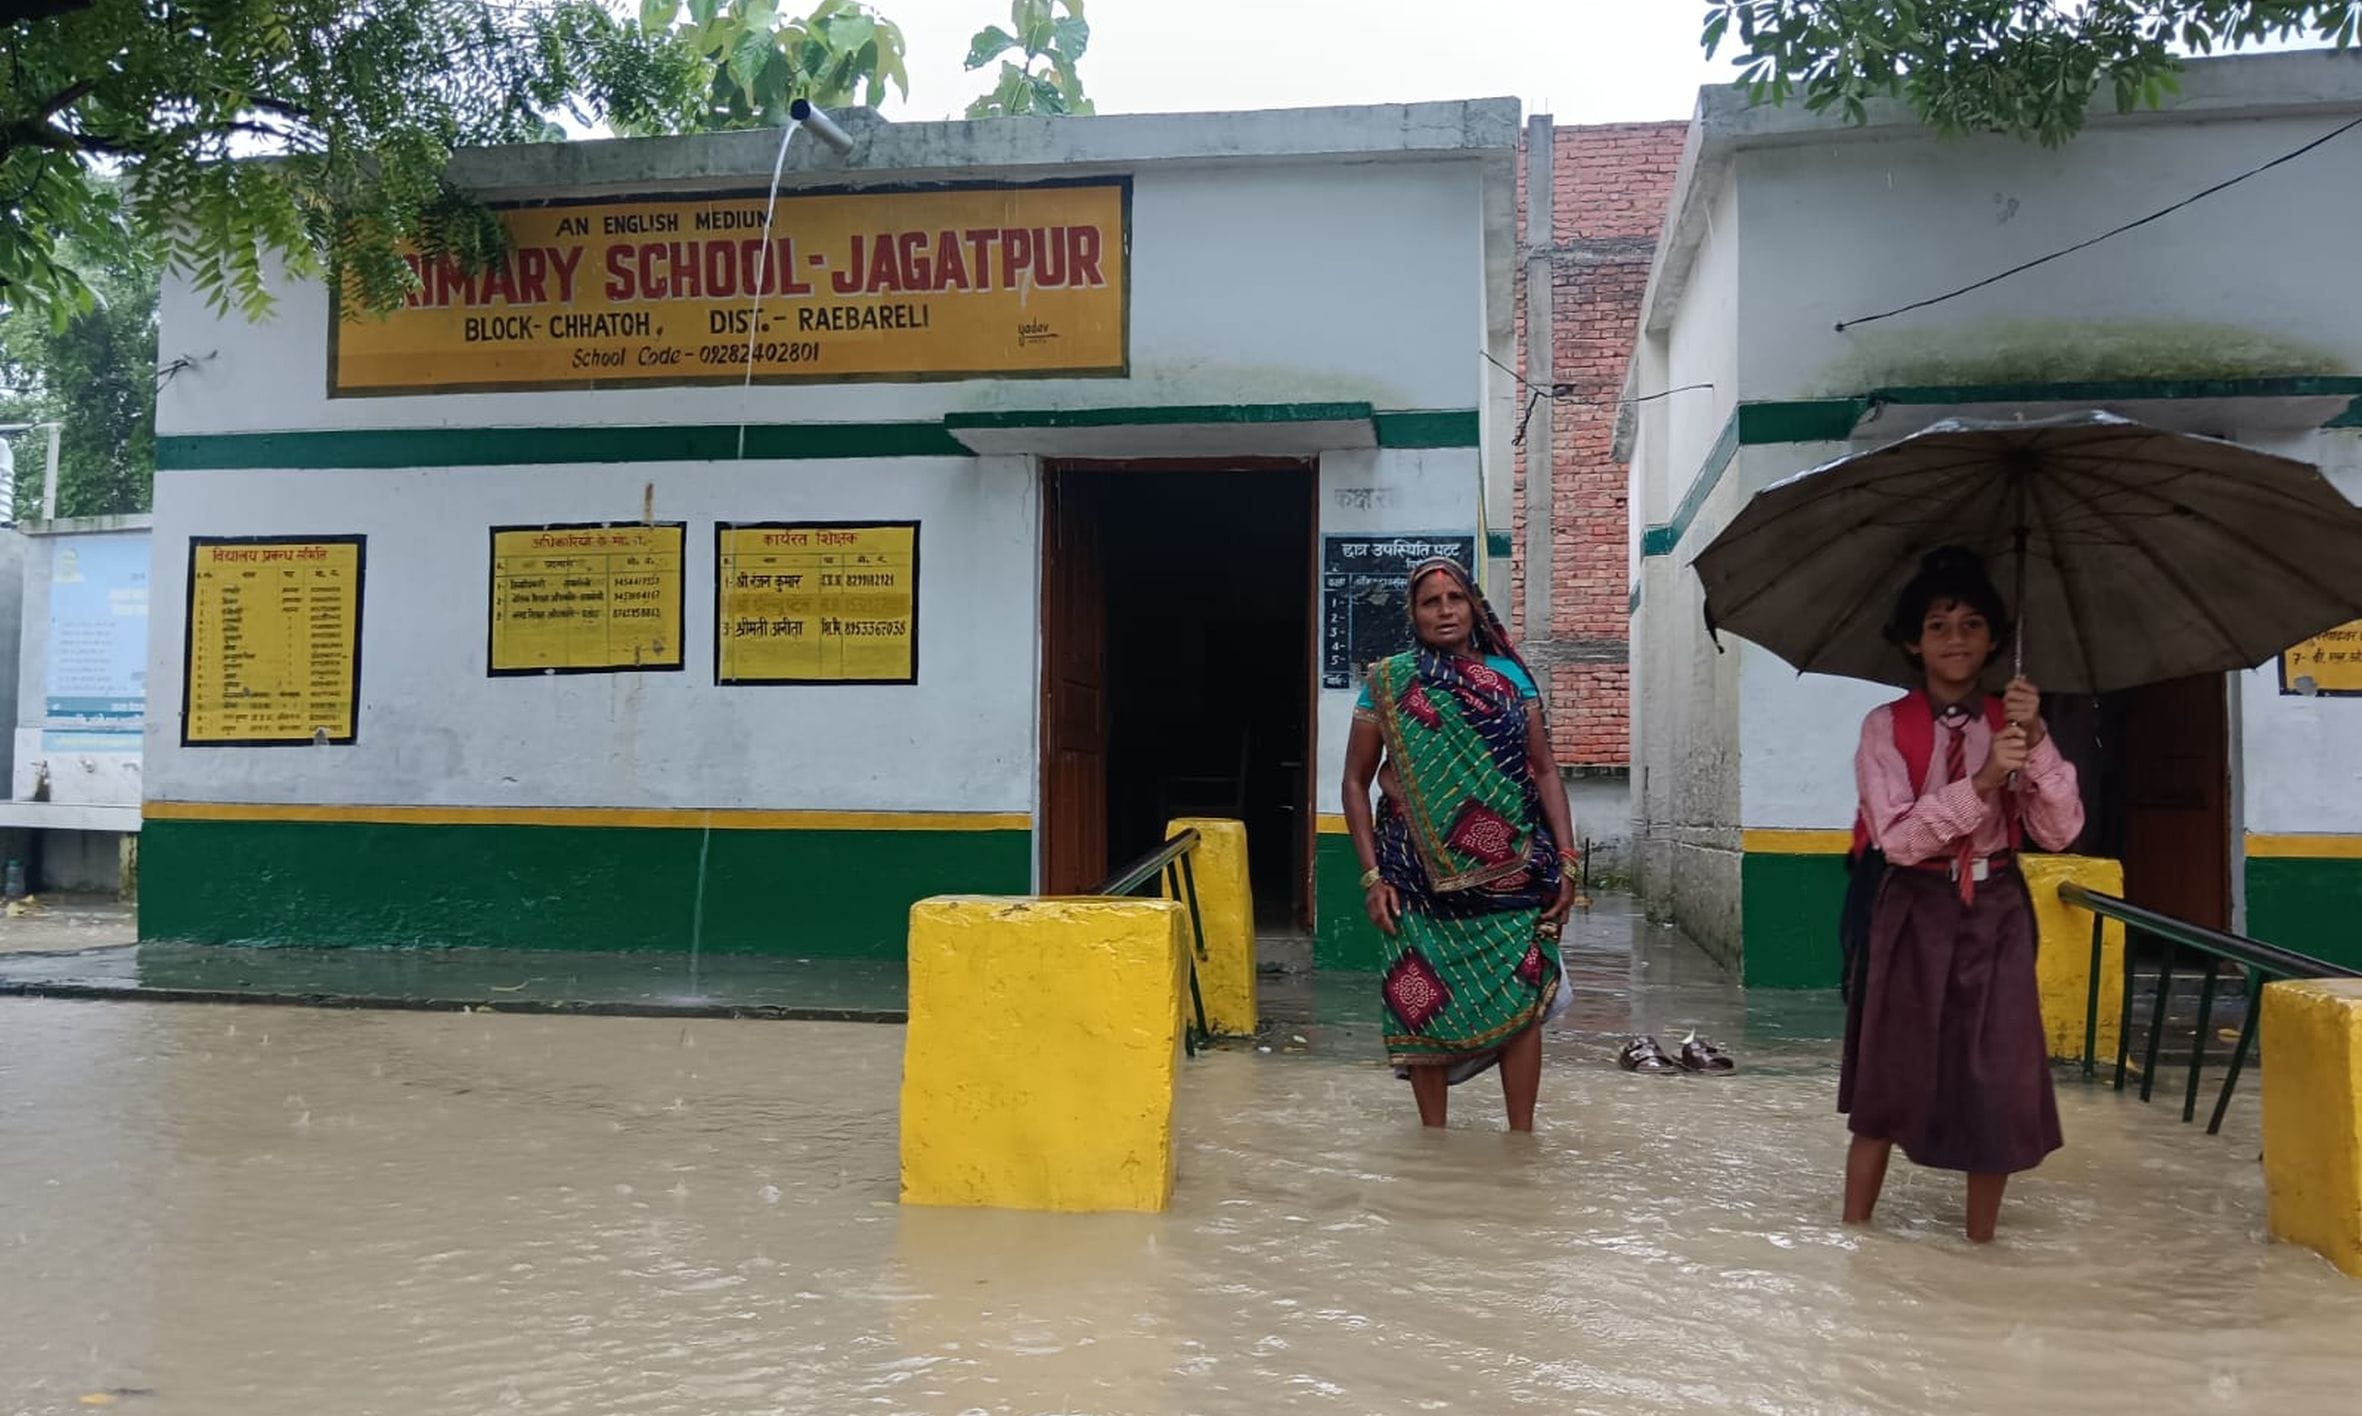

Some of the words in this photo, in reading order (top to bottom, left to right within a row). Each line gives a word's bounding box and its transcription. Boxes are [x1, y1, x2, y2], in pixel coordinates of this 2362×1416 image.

[555, 217, 589, 237] AN
[604, 213, 679, 235] ENGLISH
[798, 304, 930, 332] RAEBARELI
[572, 348, 626, 369] School
[763, 531, 809, 547] कार्यरत
[735, 616, 768, 637] श्रीमती
